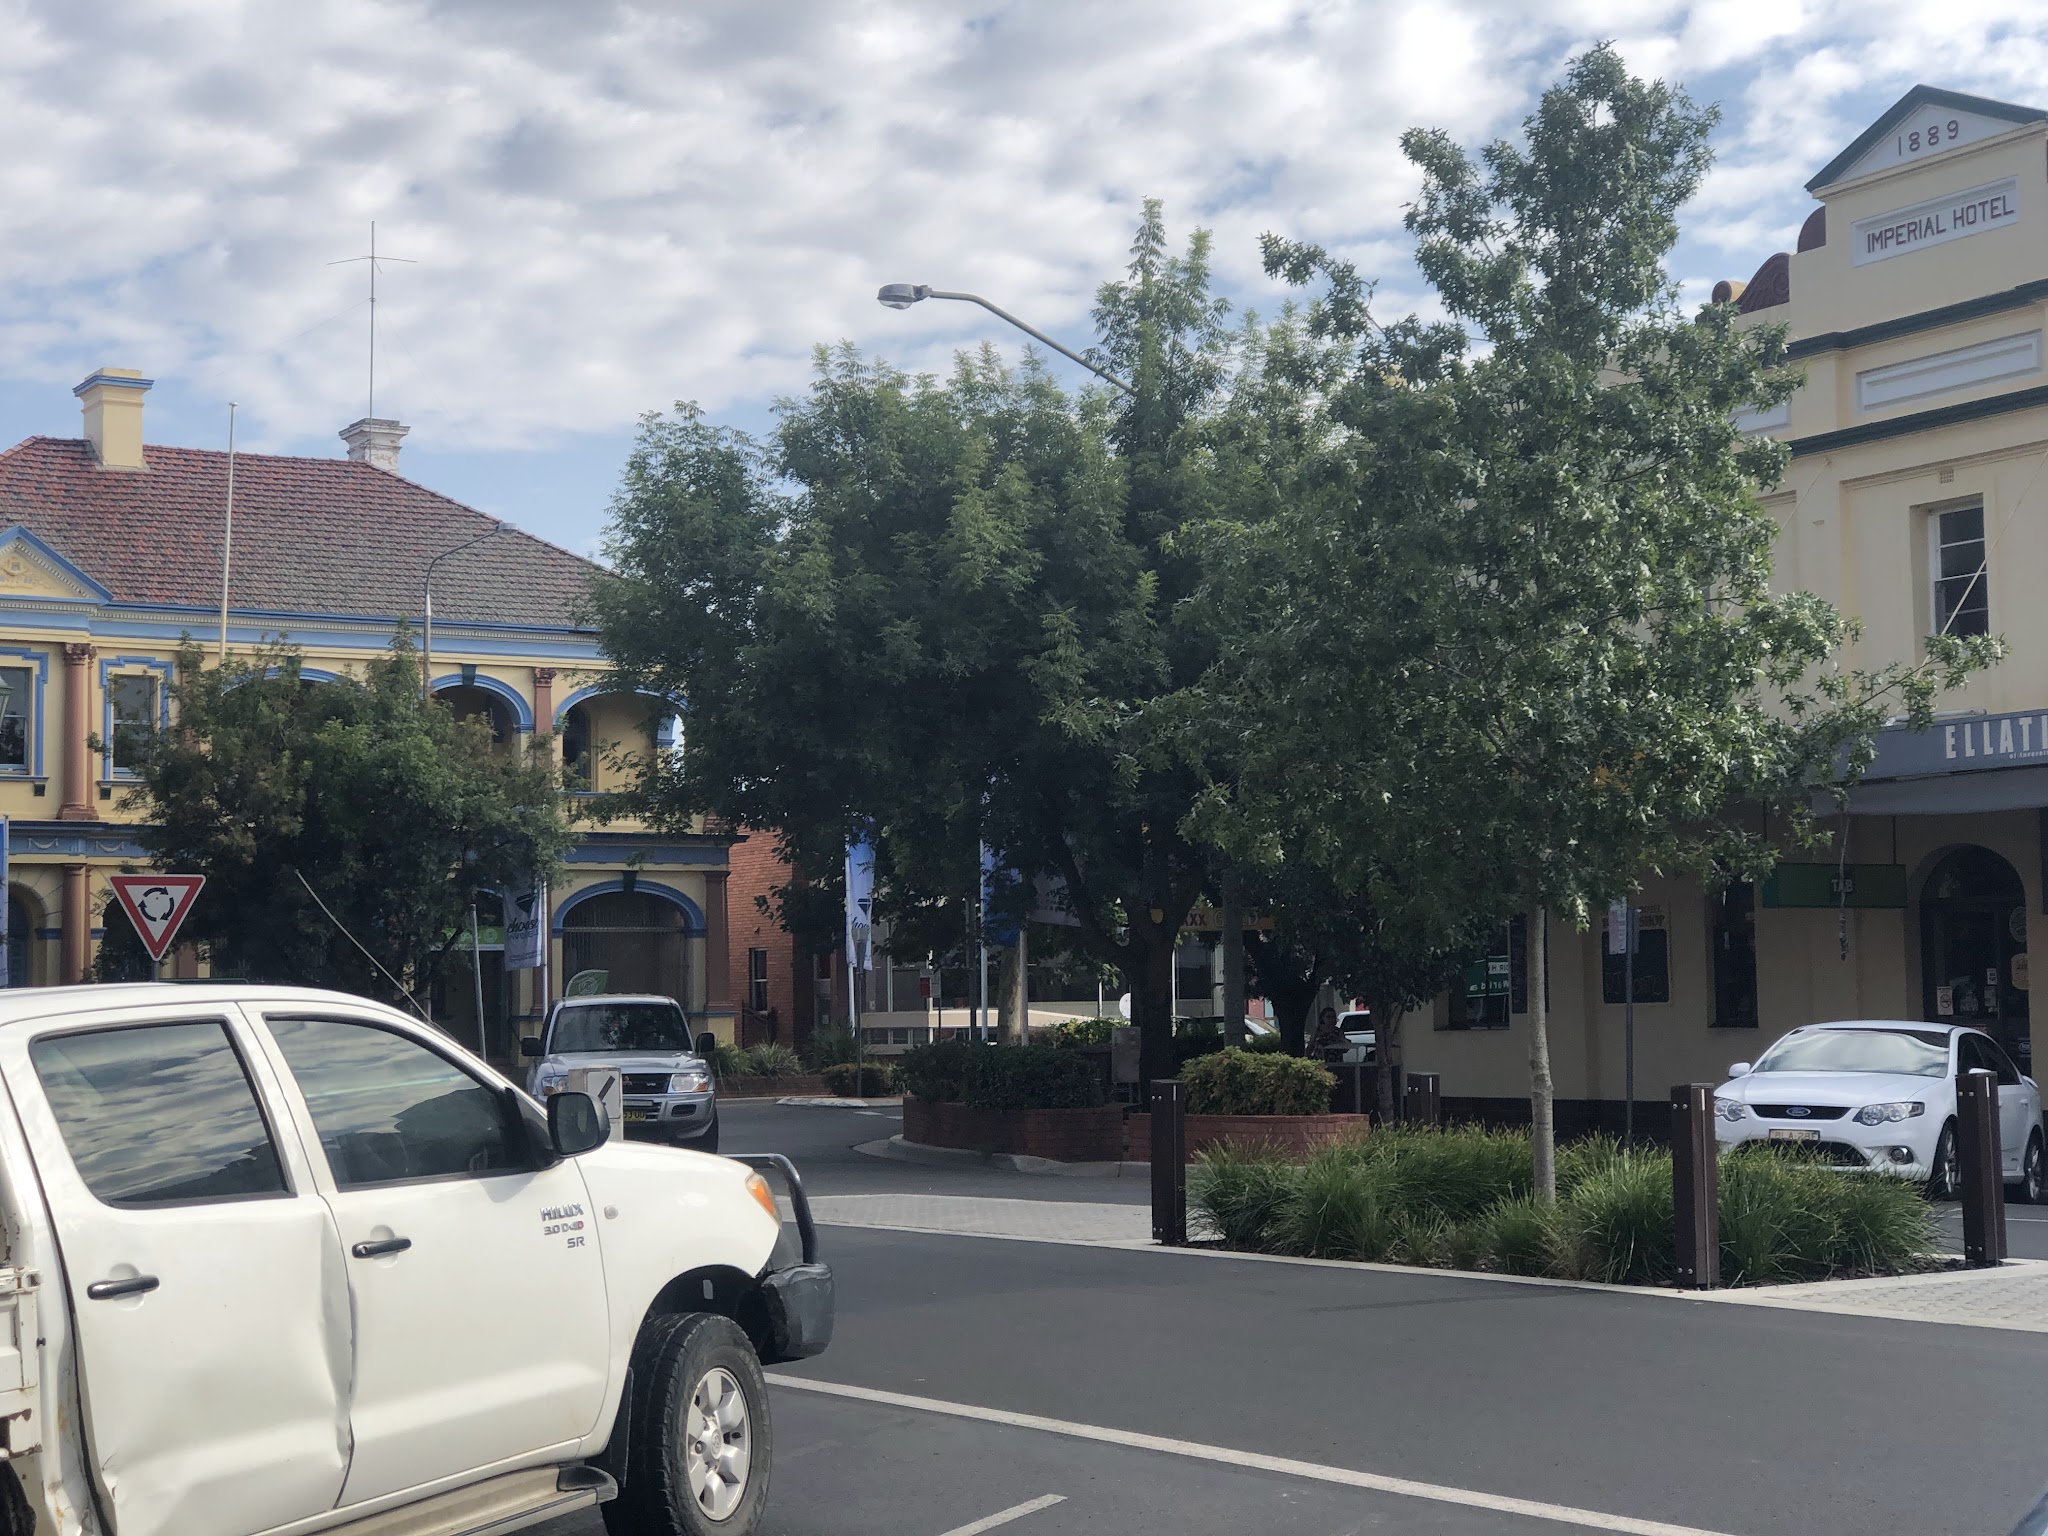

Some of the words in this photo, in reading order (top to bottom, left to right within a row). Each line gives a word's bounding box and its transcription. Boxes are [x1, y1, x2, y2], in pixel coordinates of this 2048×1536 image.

[1898, 119, 1960, 156] 1889
[1866, 214, 1947, 254] IMPERIAL
[1953, 194, 2015, 230] HOTEL
[539, 1203, 584, 1221] HILUX
[567, 1236, 585, 1249] SR
